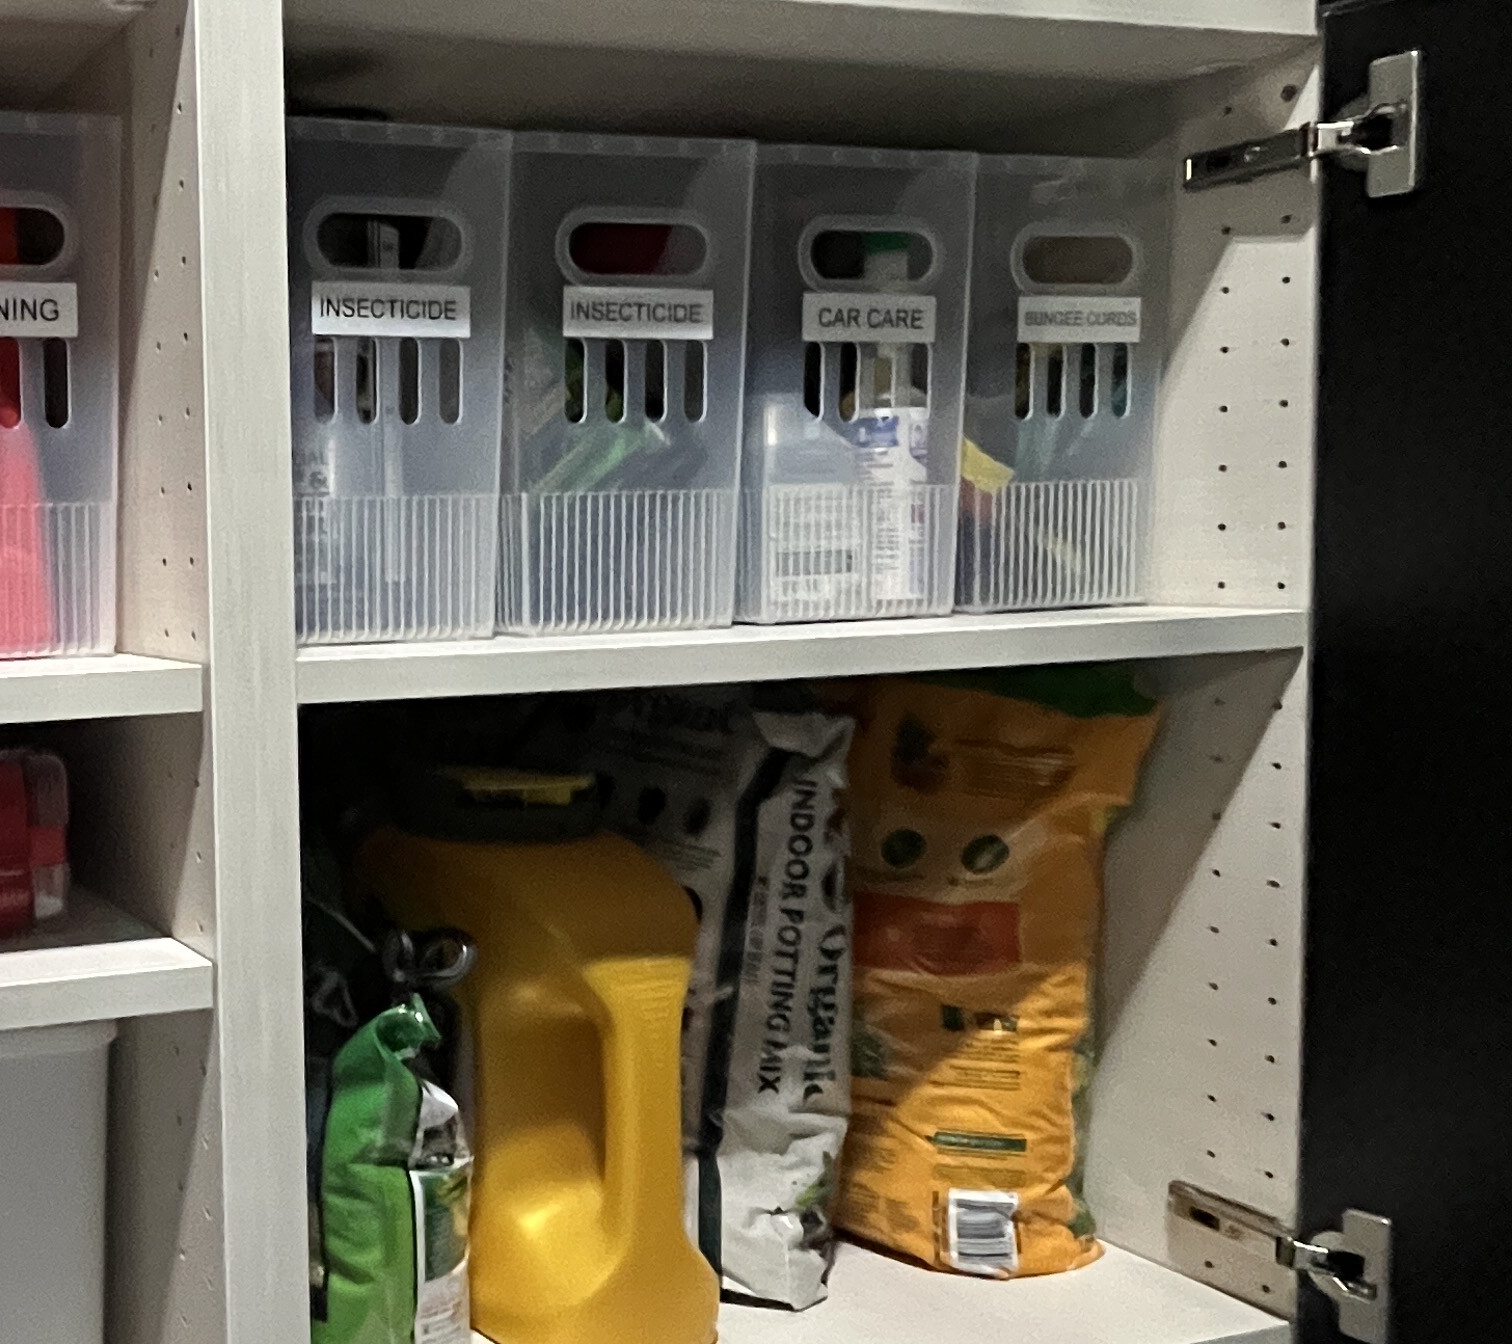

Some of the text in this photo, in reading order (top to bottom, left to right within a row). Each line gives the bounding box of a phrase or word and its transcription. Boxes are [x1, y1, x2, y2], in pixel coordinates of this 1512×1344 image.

[320, 297, 457, 321] INSECTICIDE
[570, 300, 703, 324] INSECTICIDE
[818, 307, 925, 330] CAR CARE
[757, 778, 819, 1095] INDOOR POTTING MIX
